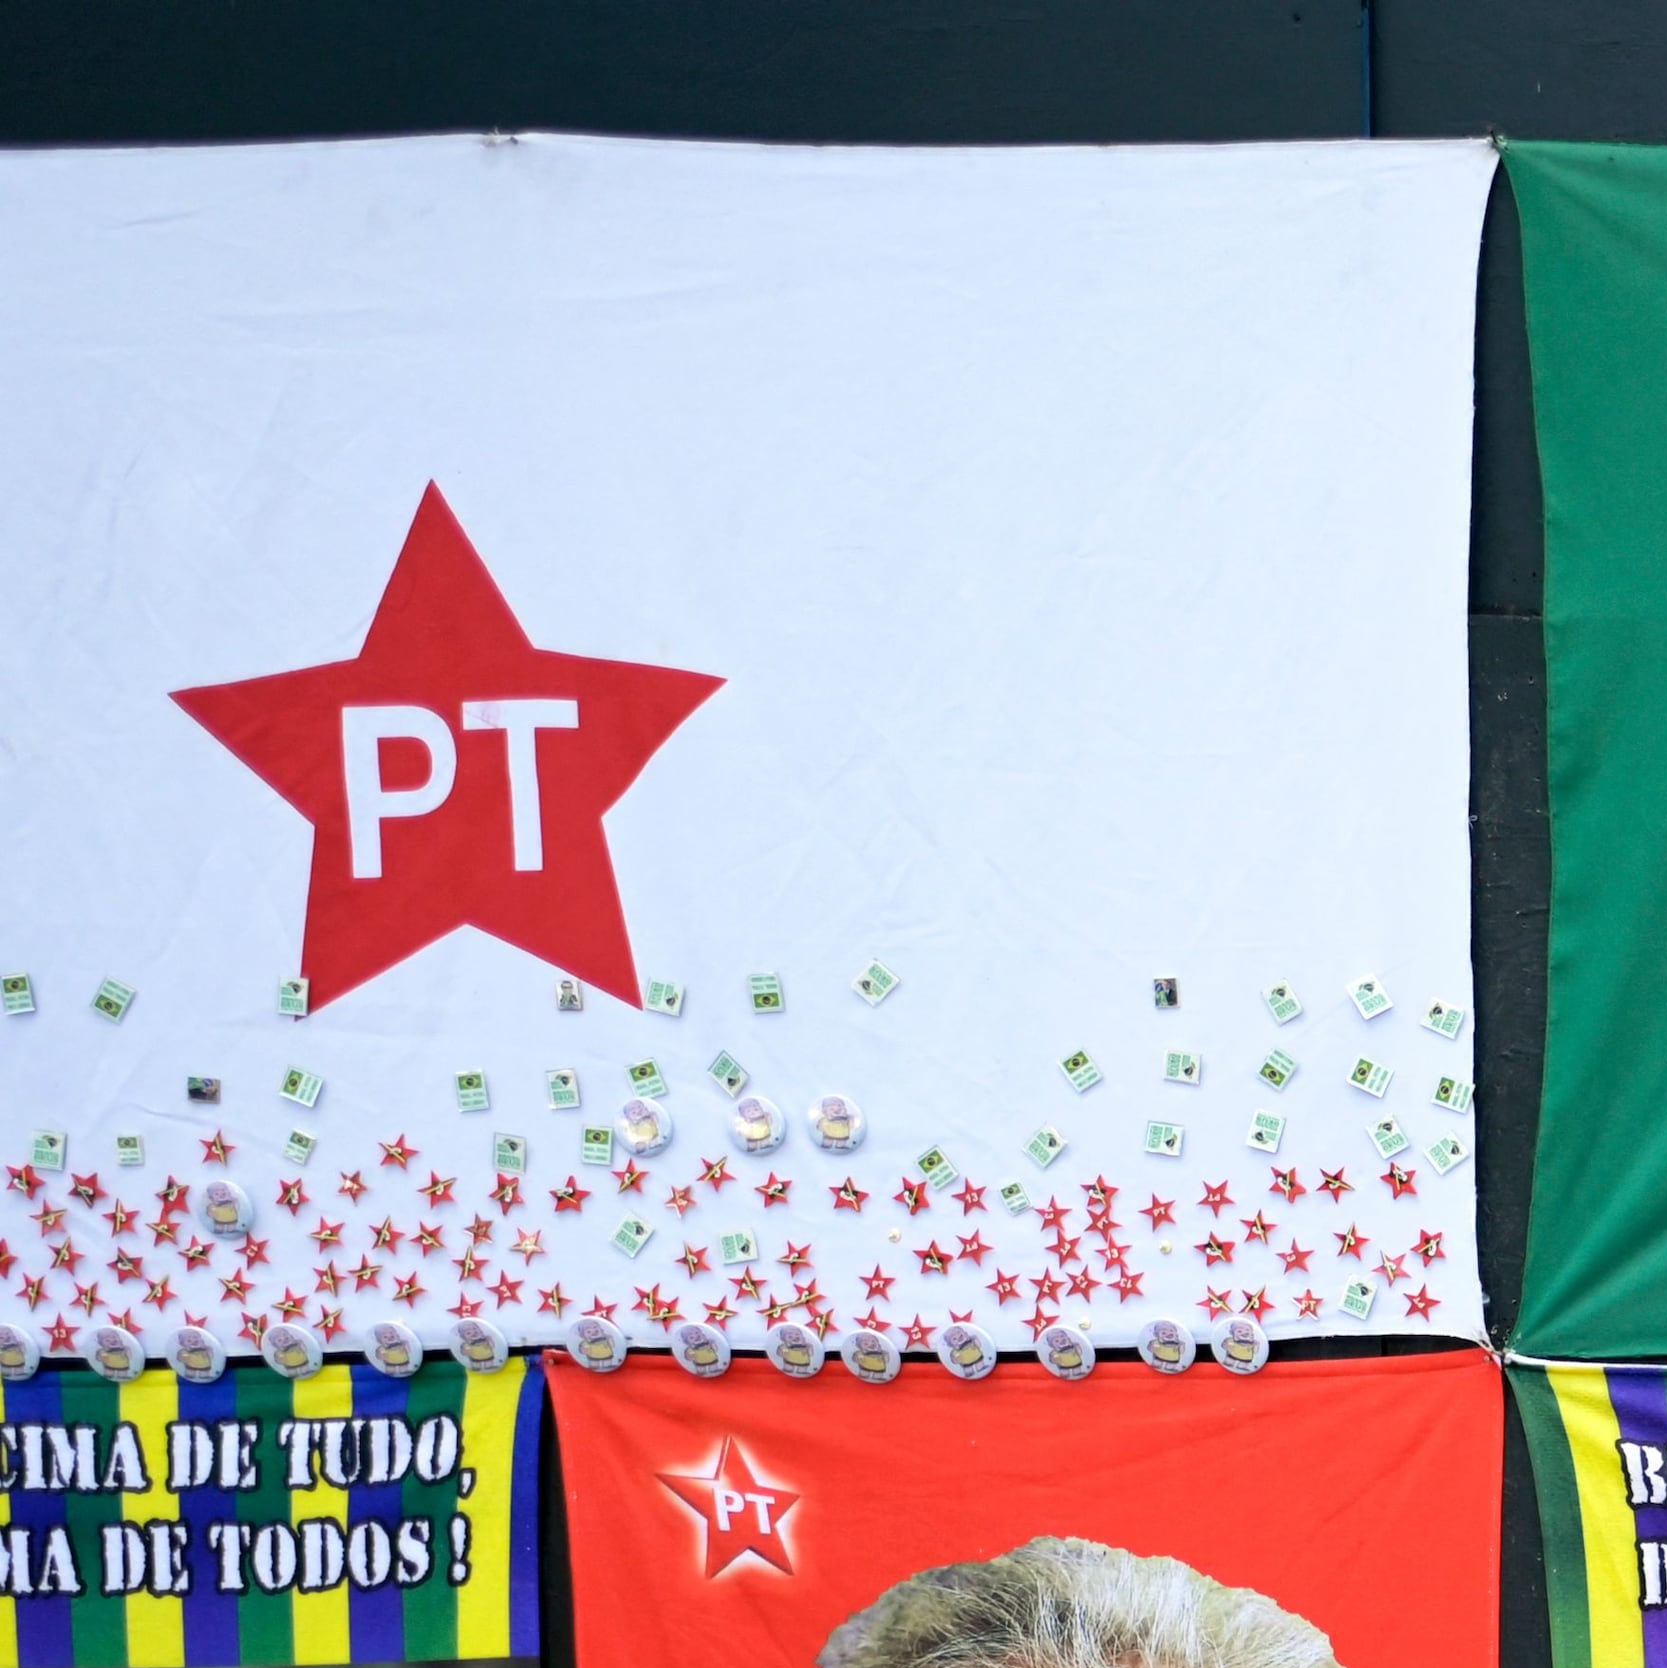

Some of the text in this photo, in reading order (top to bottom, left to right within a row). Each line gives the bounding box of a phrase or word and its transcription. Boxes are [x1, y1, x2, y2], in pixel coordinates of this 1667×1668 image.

[342, 700, 580, 880] PT
[966, 1192, 979, 1204] 13
[1153, 1206, 1166, 1217] PT
[1105, 1248, 1119, 1259] 13
[872, 1280, 886, 1289] PT
[997, 1282, 1011, 1294] 13
[1301, 1300, 1316, 1311] PT
[53, 1329, 67, 1339] 13
[911, 1326, 922, 1339] 13
[169, 1422, 259, 1489] DE
[278, 1414, 473, 1497] TUDO,
[713, 1487, 776, 1535] PT
[101, 1524, 190, 1593] DE
[208, 1519, 431, 1591] TODOS
